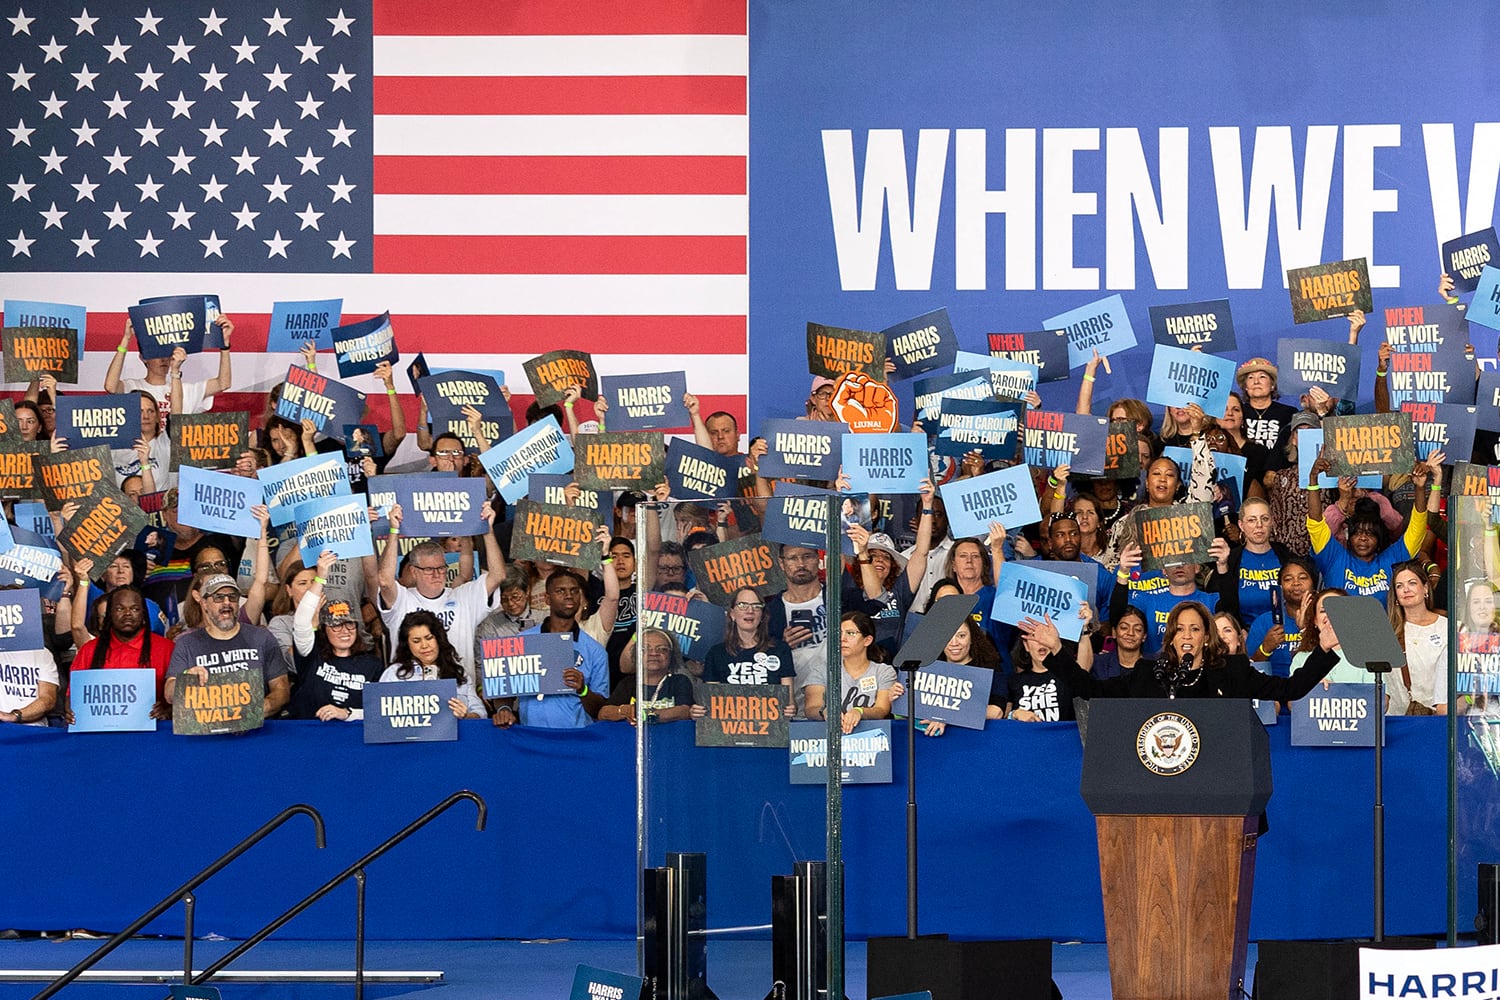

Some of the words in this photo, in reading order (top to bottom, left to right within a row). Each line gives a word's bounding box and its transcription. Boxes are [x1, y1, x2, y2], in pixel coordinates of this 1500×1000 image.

[822, 128, 1188, 290] WHEN
[1210, 125, 1400, 287] WE
[1300, 269, 1361, 300] HARRIS
[1312, 291, 1355, 311] WALZ
[144, 311, 195, 336] HARRIS
[285, 312, 329, 330] HARRIS
[155, 331, 190, 346] WALZ
[291, 328, 321, 340] WALZ
[288, 365, 328, 395] WHEN
[282, 382, 305, 405] WE
[303, 390, 337, 421] VOTE,
[618, 384, 672, 408] HARRIS
[71, 407, 126, 427] HARRIS
[278, 398, 300, 421] WE
[300, 407, 327, 431] WIN
[627, 404, 665, 418] WALZ
[80, 425, 118, 438] WALZ
[940, 413, 973, 429] NORTH
[974, 415, 1018, 432] CAROLINA
[1246, 418, 1279, 432] YES
[181, 423, 239, 447] HARRIS
[775, 432, 831, 455] HARRIS
[950, 428, 980, 444] VOTES
[980, 431, 1008, 445] EARLY
[1246, 430, 1279, 442] SHE
[1335, 425, 1401, 449] HARRIS
[190, 446, 231, 461] WALZ
[488, 451, 522, 480] NORTH
[519, 430, 565, 461] CAROLINA
[783, 453, 822, 467] WALZ
[859, 447, 913, 467] HARRIS
[1345, 448, 1393, 466] WALZ
[506, 461, 536, 484] VOTES
[533, 446, 560, 469] EARLY
[867, 466, 906, 479] WALZ
[412, 491, 471, 511] HARRIS
[960, 481, 1018, 512] HARRIS
[423, 510, 463, 523] WALZ
[974, 503, 1013, 521] WALZ
[1345, 568, 1387, 587] TEAMSTERS
[1015, 579, 1073, 610] HARRIS
[1344, 581, 1357, 590] for
[1358, 581, 1389, 596] HARRIS
[1021, 601, 1061, 621] WALZ
[482, 636, 524, 659] WHEN
[195, 653, 219, 667] OLD
[221, 649, 259, 663] WHITE
[483, 657, 511, 679] WE
[512, 655, 547, 677] VOTE,
[83, 684, 137, 704] HARRIS
[184, 682, 251, 709] HARRIS
[484, 675, 513, 699] WE
[515, 674, 540, 695] WIN
[90, 704, 128, 716] WALZ
[380, 694, 440, 716] HARRIS
[1308, 697, 1367, 719] HARRIS
[193, 707, 242, 724] WALZ
[390, 715, 432, 728] WALZ
[1317, 718, 1359, 731] WALZ
